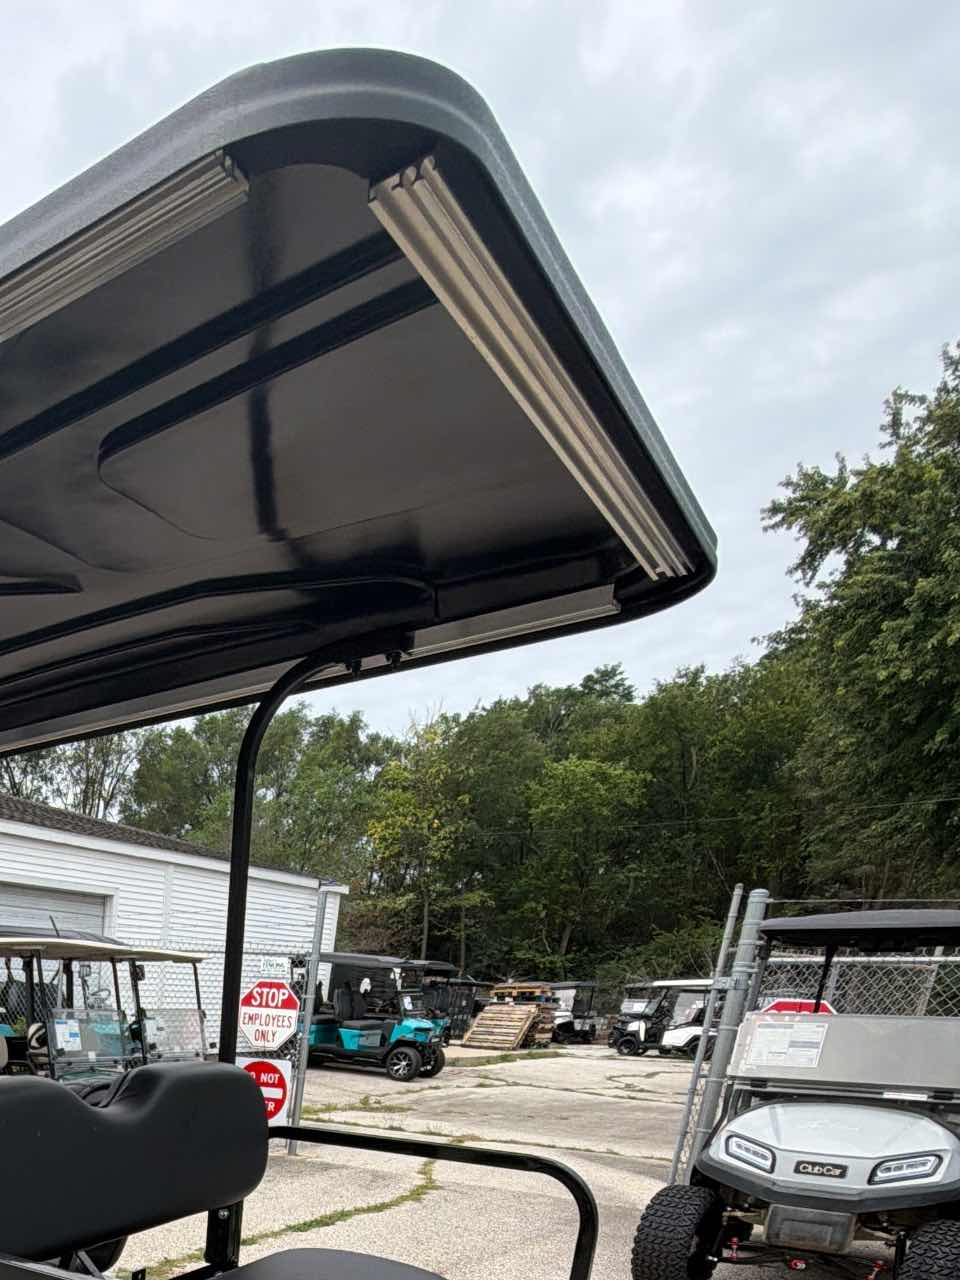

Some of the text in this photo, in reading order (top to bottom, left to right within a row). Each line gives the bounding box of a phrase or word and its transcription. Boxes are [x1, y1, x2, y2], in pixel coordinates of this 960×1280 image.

[251, 987, 288, 1007] STOP
[242, 1012, 292, 1028] EMPLOYEES
[254, 1028, 277, 1042] ONLY
[260, 1072, 281, 1084] NOT
